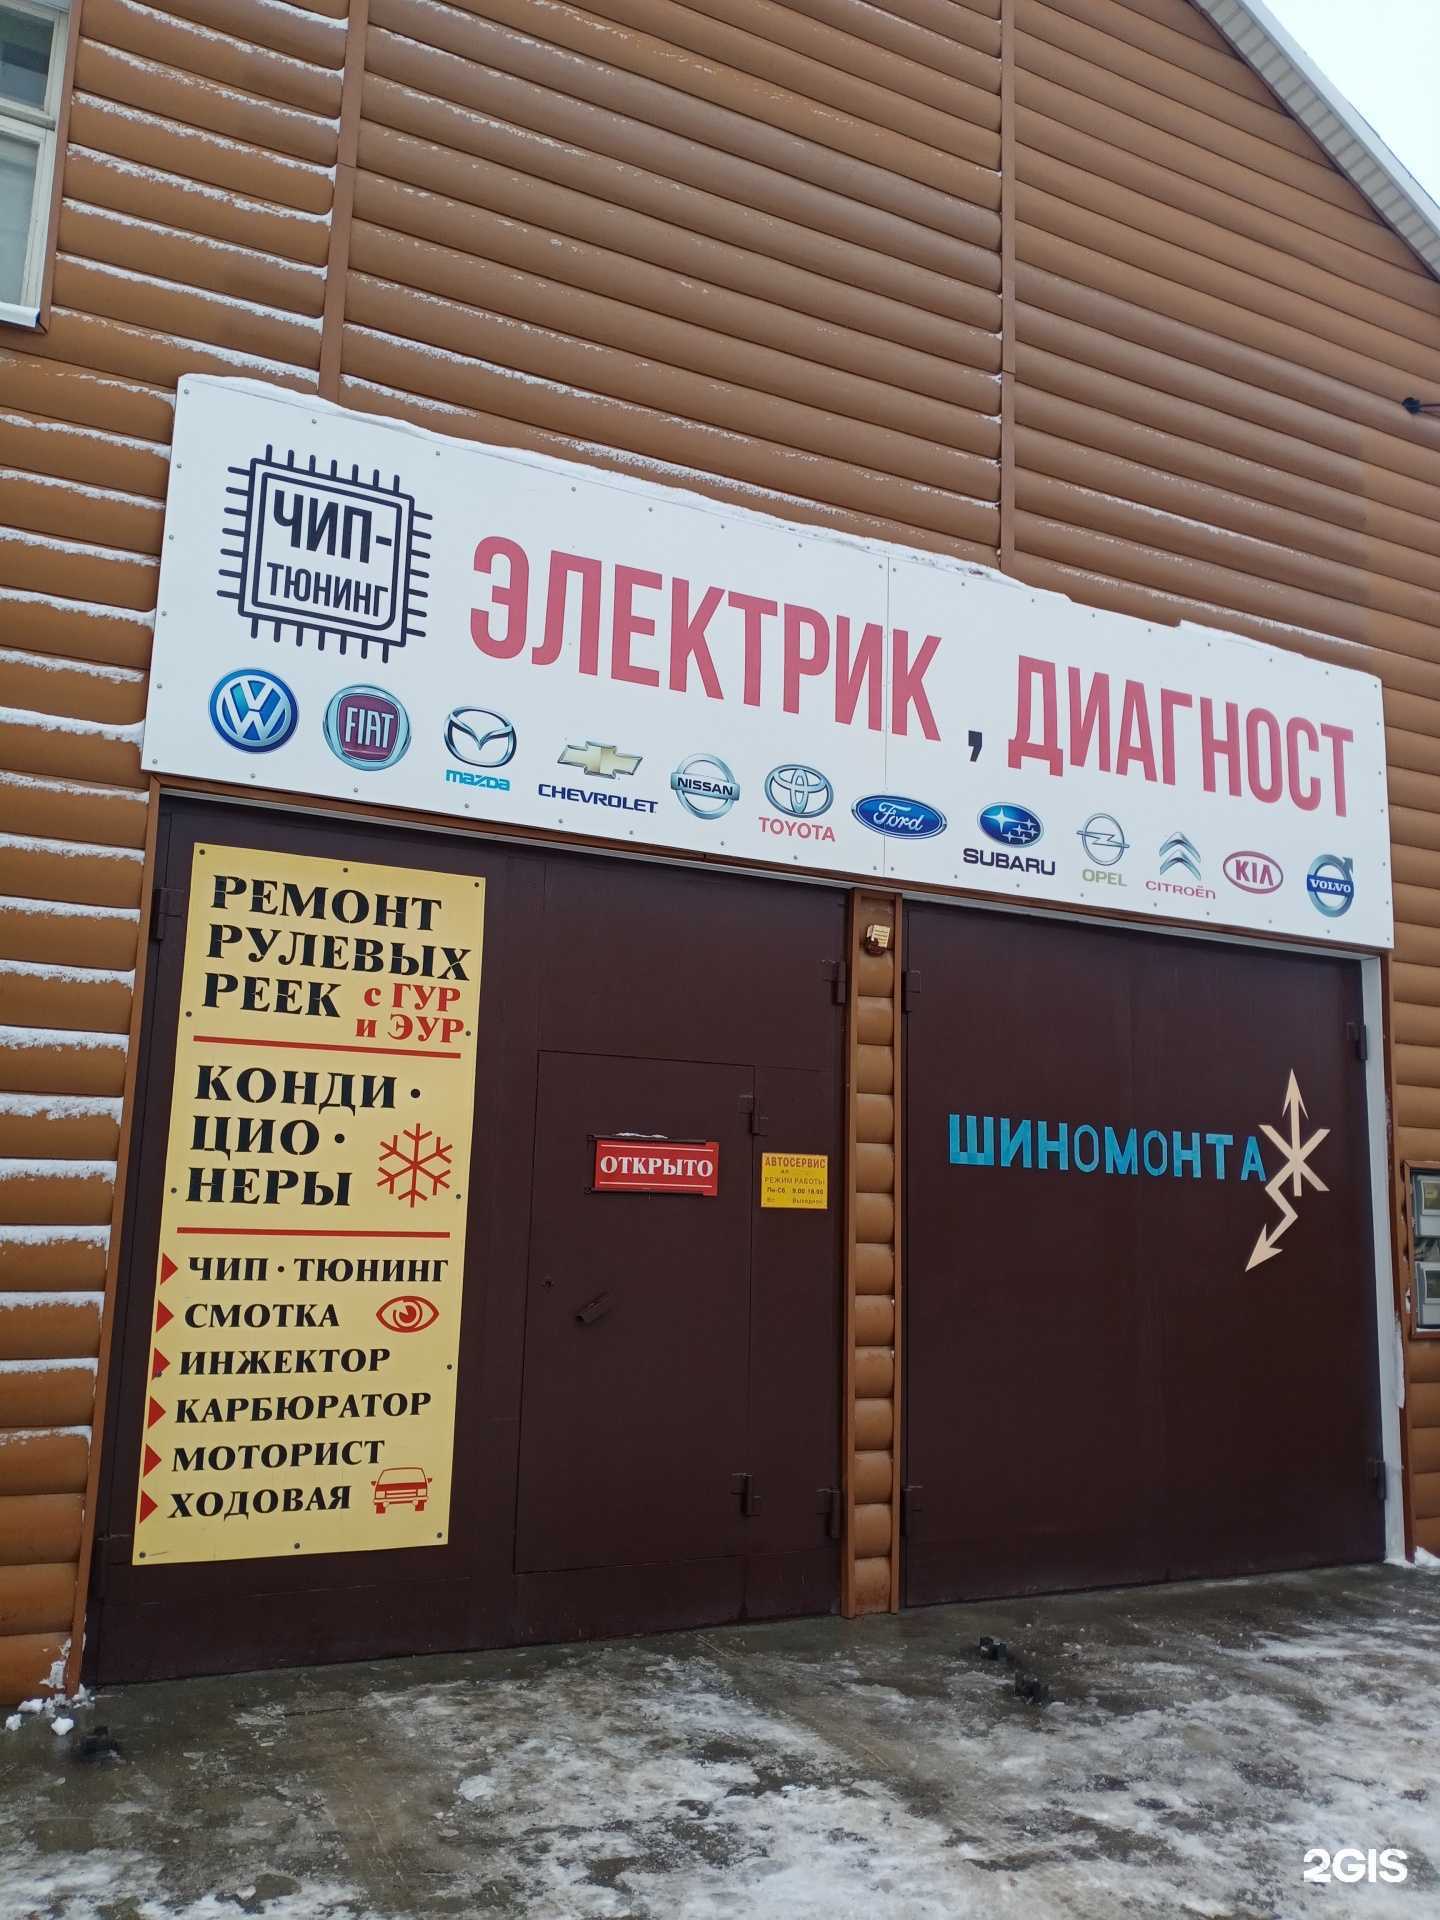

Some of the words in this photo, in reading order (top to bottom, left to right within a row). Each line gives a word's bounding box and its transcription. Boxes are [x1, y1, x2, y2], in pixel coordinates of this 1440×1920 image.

[273, 490, 393, 564] ЧИП-
[266, 561, 389, 618] ТЮНИНГ
[470, 535, 942, 742] ЭЛЕКТРИК
[1008, 654, 1354, 818] ДИАГНОСТ
[345, 706, 395, 749] FIAT
[538, 783, 658, 814] CHEVROLET
[677, 776, 734, 796] NISSAN
[758, 816, 836, 842] TOYOTA
[873, 801, 924, 832] Ford
[963, 847, 1056, 876] SUBARU
[1235, 858, 1274, 887] KIA
[1081, 868, 1128, 888] OPEL
[1309, 878, 1351, 894] VOLVO
[209, 874, 442, 931] РЕМОНТ
[206, 923, 471, 982] РУЛЕВЫХ
[201, 972, 343, 1019] РЕЕК
[392, 982, 461, 1013] ГУР
[387, 1013, 465, 1044] ЭУР
[600, 1155, 714, 1178] ОТКРЫТО
[765, 1156, 826, 1169] АВТОСЕРВИС
[185, 1167, 353, 1207] НЕРЫ
[184, 1302, 340, 1329] СМОТКА
[179, 1348, 391, 1376] ИНЖЕКТОР
[174, 1392, 432, 1423] КАРБЮРАТОР
[171, 1439, 385, 1472] МОТОРИСТ
[167, 1485, 352, 1521] ХОДОВАЯ
